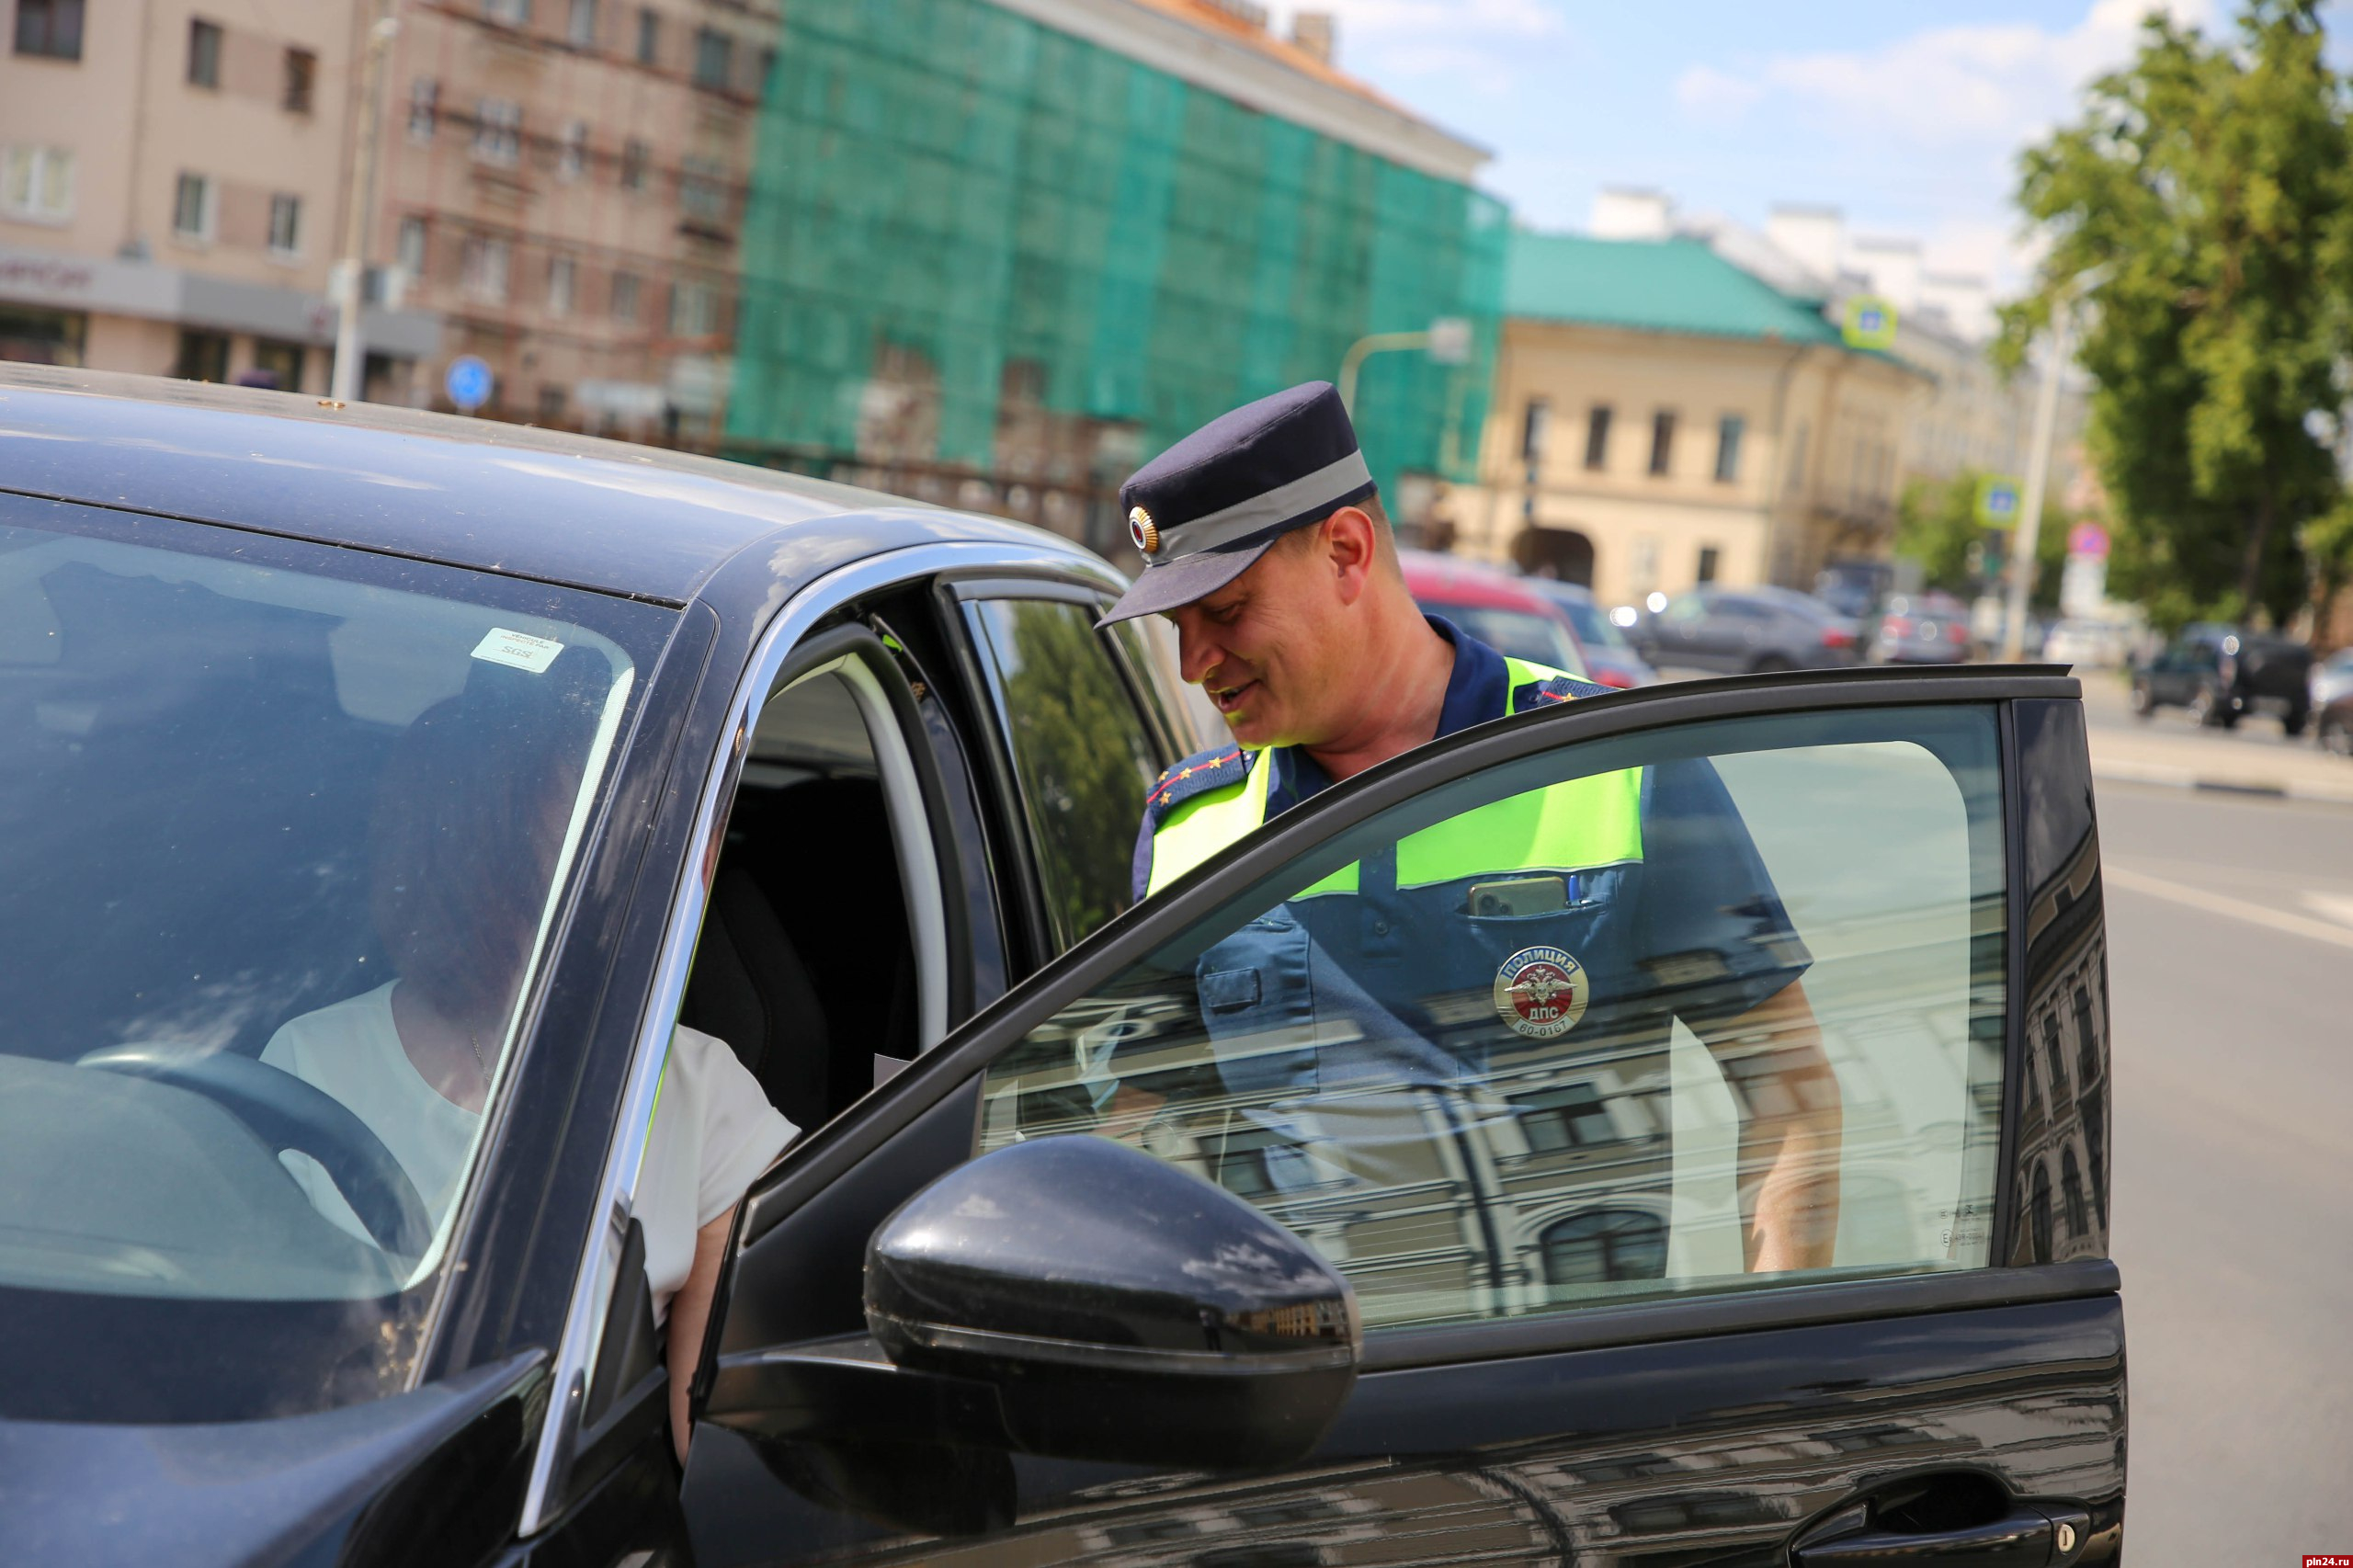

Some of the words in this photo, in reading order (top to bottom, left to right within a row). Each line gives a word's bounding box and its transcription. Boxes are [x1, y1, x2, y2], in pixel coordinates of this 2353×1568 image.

[502, 645, 532, 658] SGS
[1504, 949, 1576, 978] ПОЛИЦИЯ
[1529, 1006, 1559, 1021] ДПС
[1519, 1021, 1566, 1036] 60-0167
